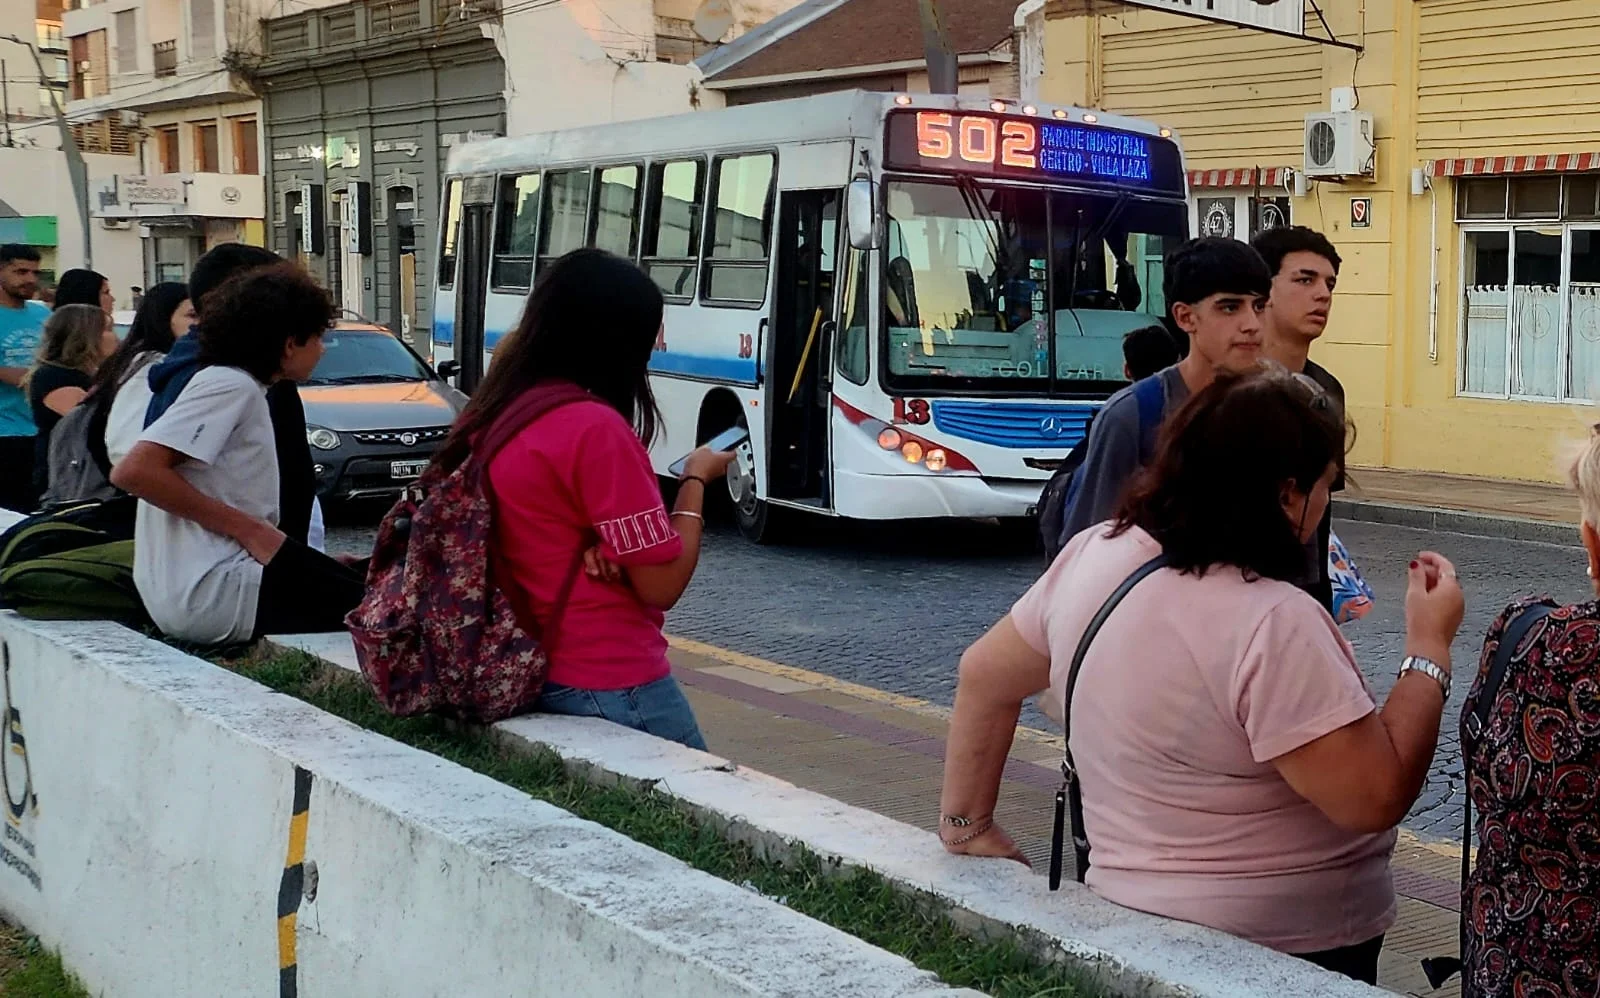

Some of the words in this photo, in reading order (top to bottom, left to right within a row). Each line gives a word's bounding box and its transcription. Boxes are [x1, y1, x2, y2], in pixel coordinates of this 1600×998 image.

[916, 111, 1036, 169] 502
[1041, 126, 1085, 150] PARQUE
[1086, 131, 1148, 158] INDUSTRIAL
[1040, 148, 1082, 173] CENTRO
[1091, 154, 1119, 176] VILLA
[1121, 157, 1148, 180] LAZA
[890, 396, 931, 425] 13
